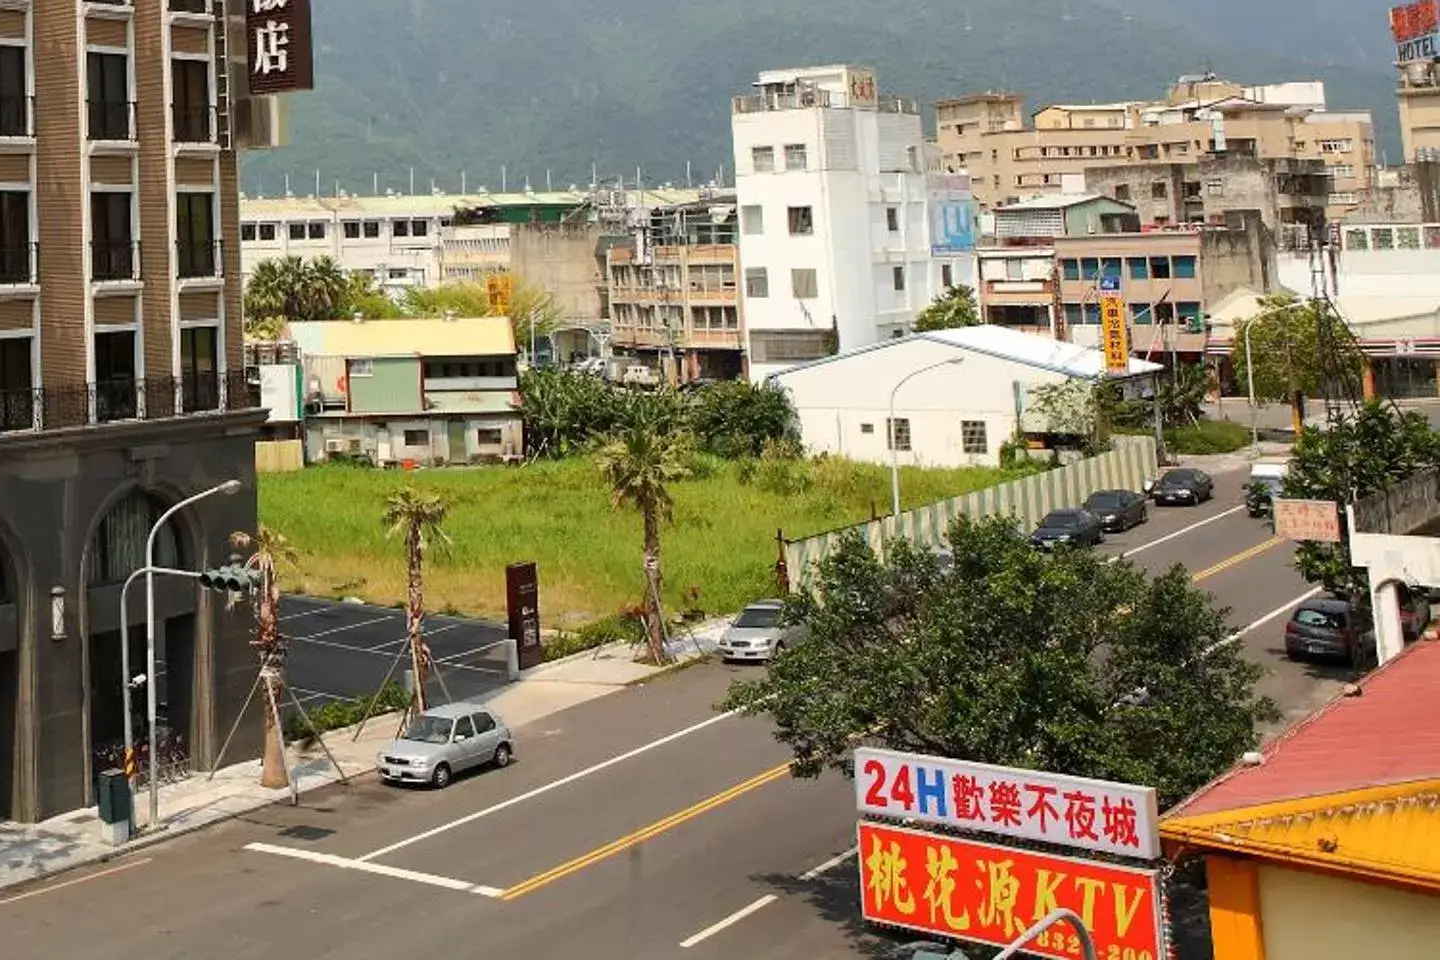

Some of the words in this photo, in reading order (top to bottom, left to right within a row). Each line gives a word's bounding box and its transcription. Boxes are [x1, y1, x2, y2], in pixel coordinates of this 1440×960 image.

[1397, 36, 1437, 62] HOTEL
[867, 835, 1145, 938] 桃花源KTV
